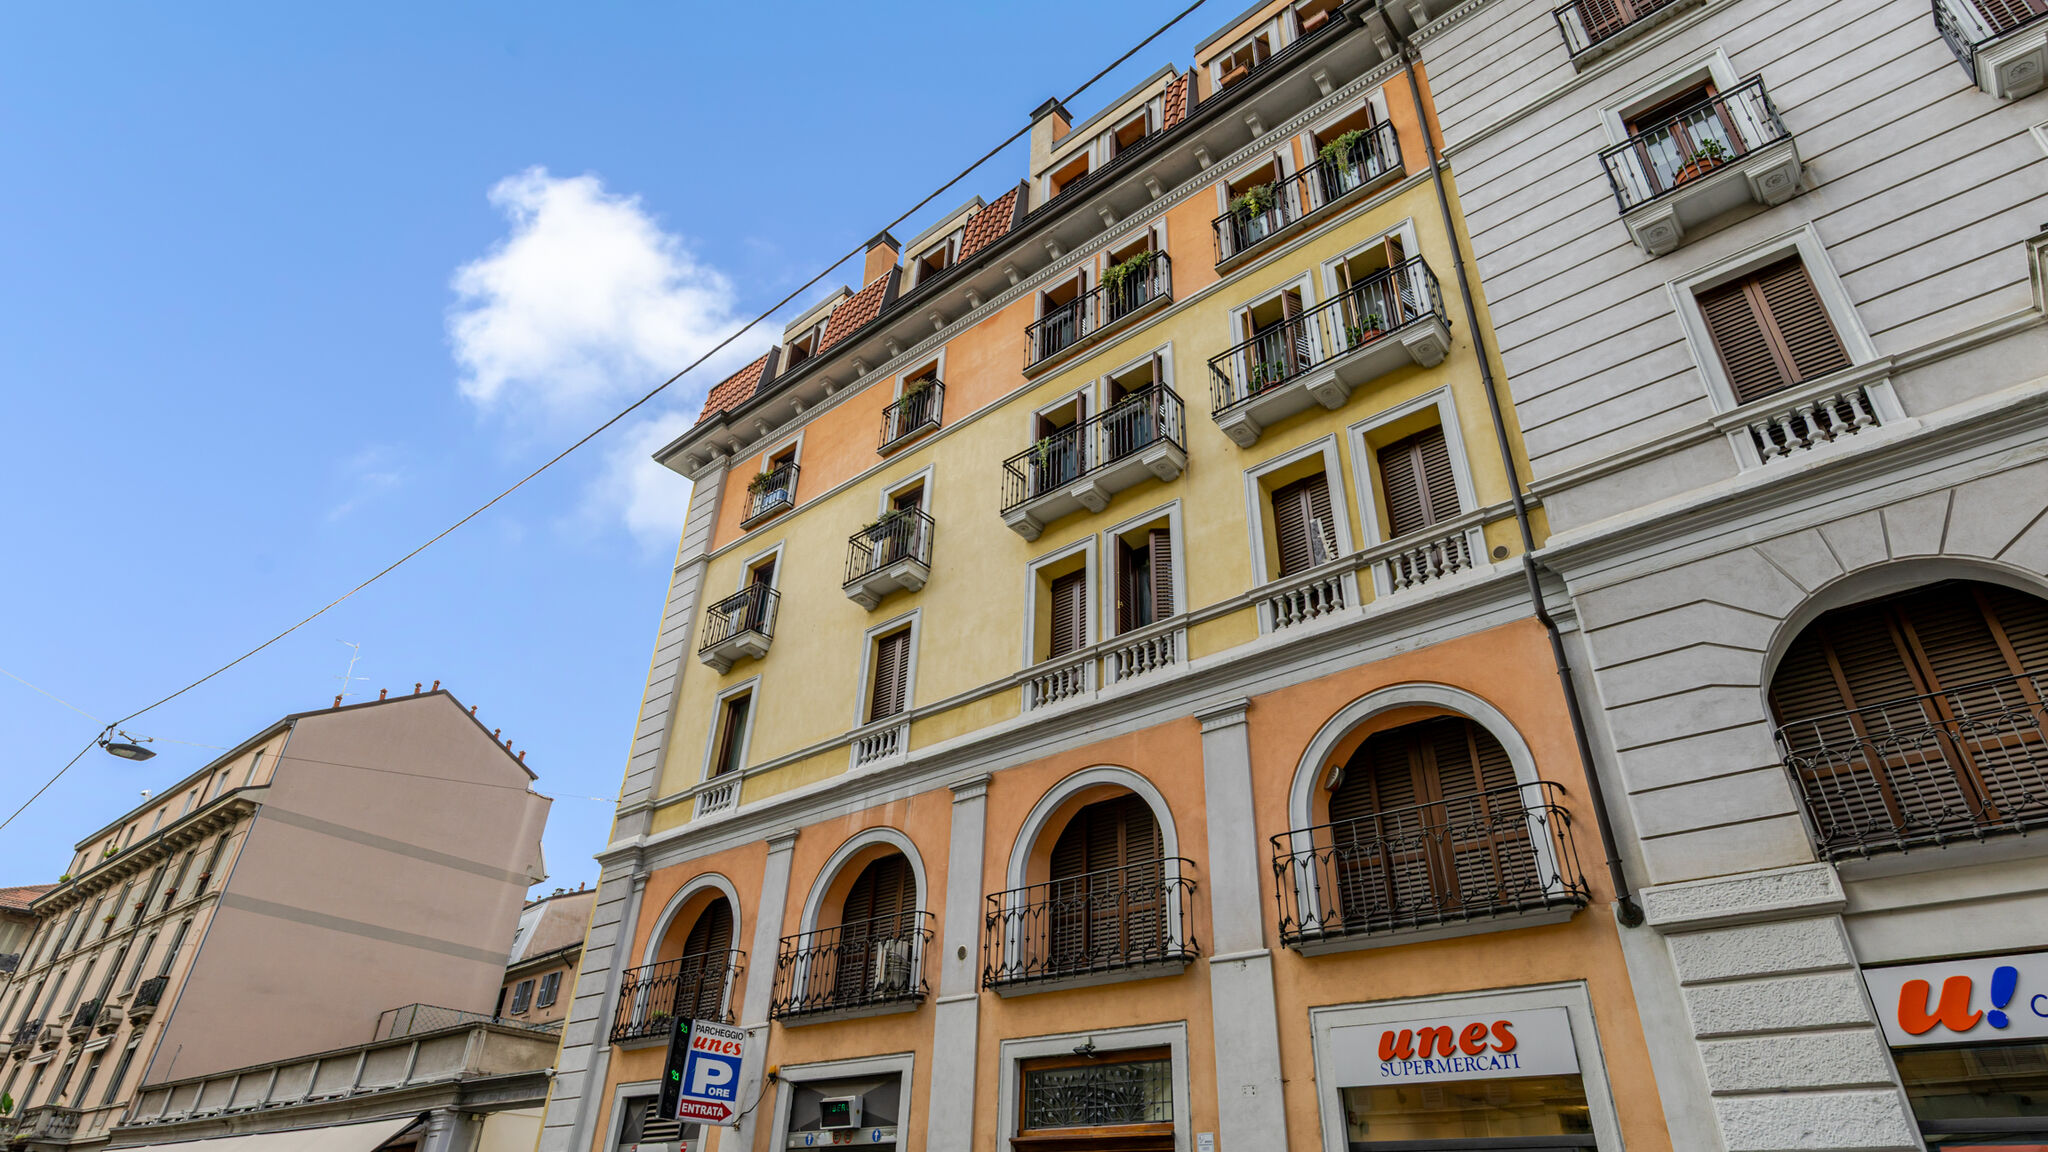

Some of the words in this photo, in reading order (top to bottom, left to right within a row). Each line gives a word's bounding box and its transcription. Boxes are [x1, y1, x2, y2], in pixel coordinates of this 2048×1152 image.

[695, 1024, 744, 1041] PARCHEGGIO
[1378, 1020, 1517, 1061] unes
[693, 1036, 742, 1056] unes
[691, 1057, 733, 1094] P
[1380, 1053, 1521, 1078] SUPERMERCATI
[707, 1087, 731, 1098] ORE
[681, 1102, 724, 1118] ENTRATA
